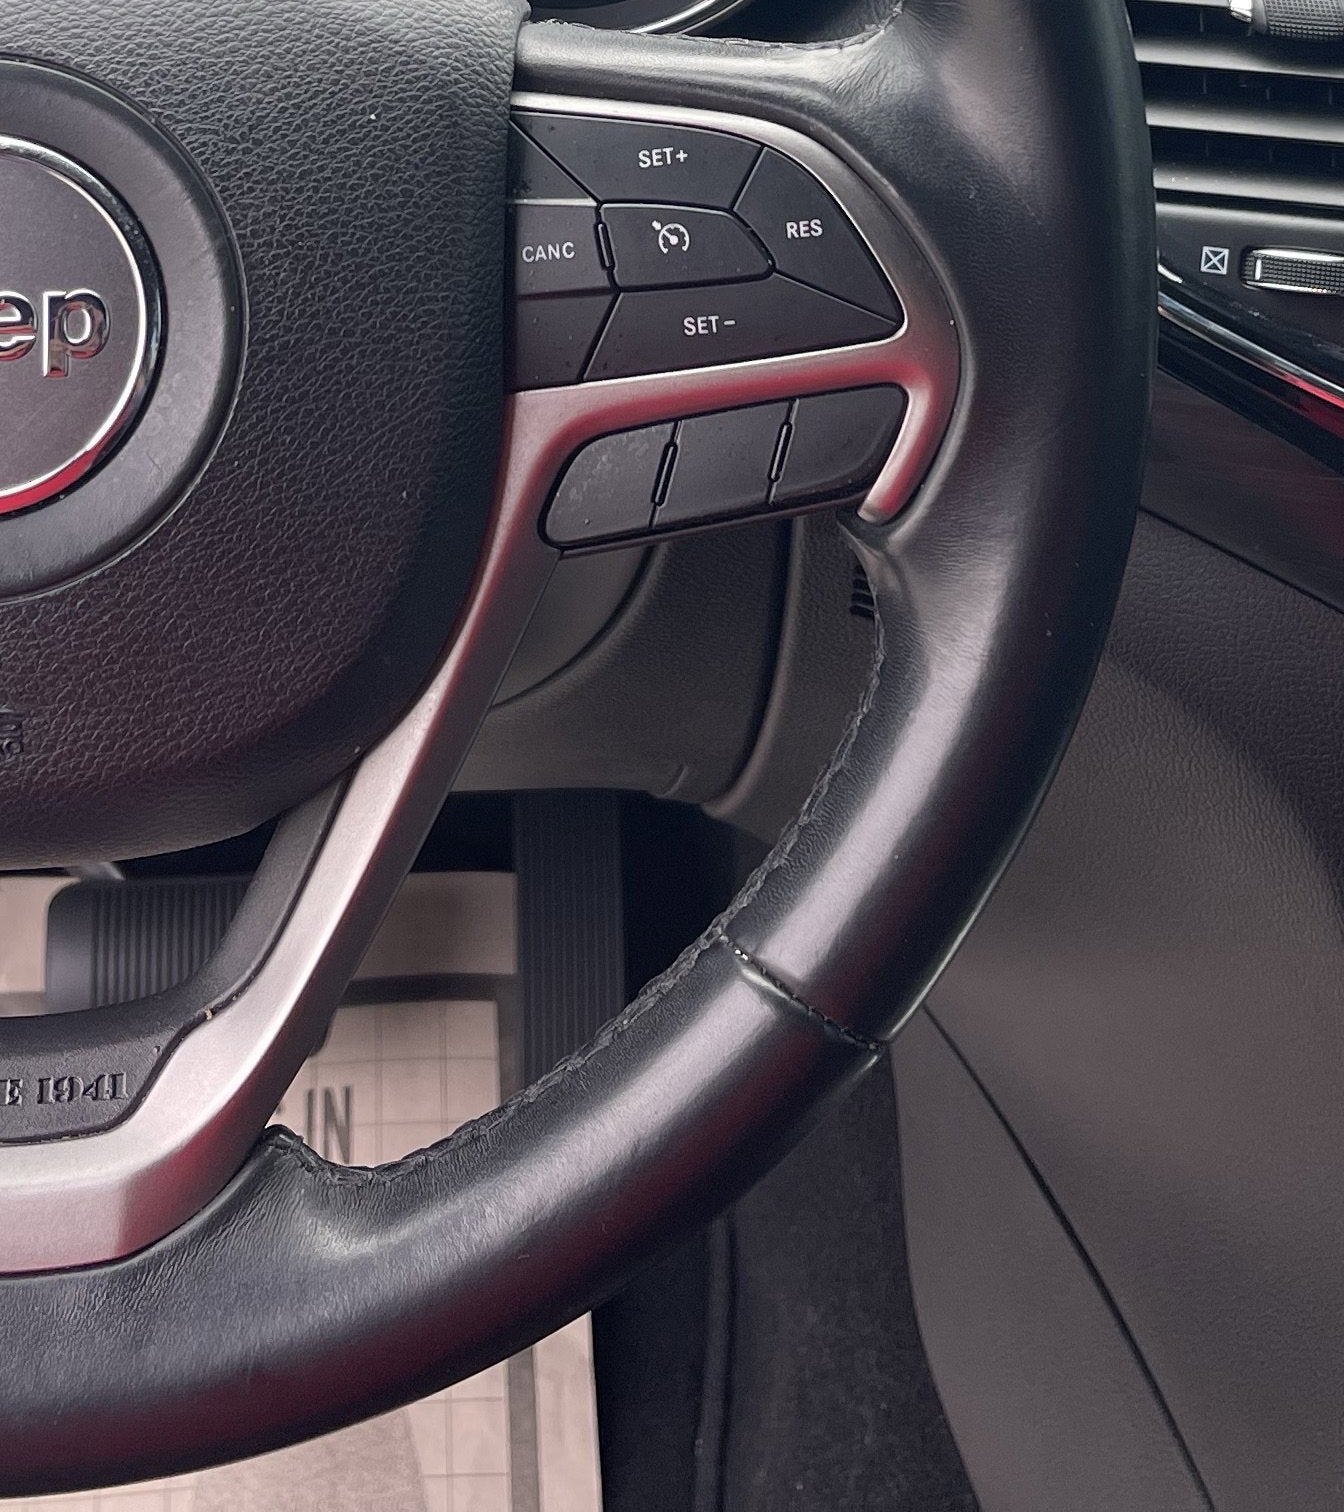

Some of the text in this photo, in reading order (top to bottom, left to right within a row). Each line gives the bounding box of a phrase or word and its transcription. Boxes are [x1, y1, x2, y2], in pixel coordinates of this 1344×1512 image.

[786, 219, 823, 239] RES
[522, 241, 575, 263] CANC
[37, 1072, 129, 1105] 1941
